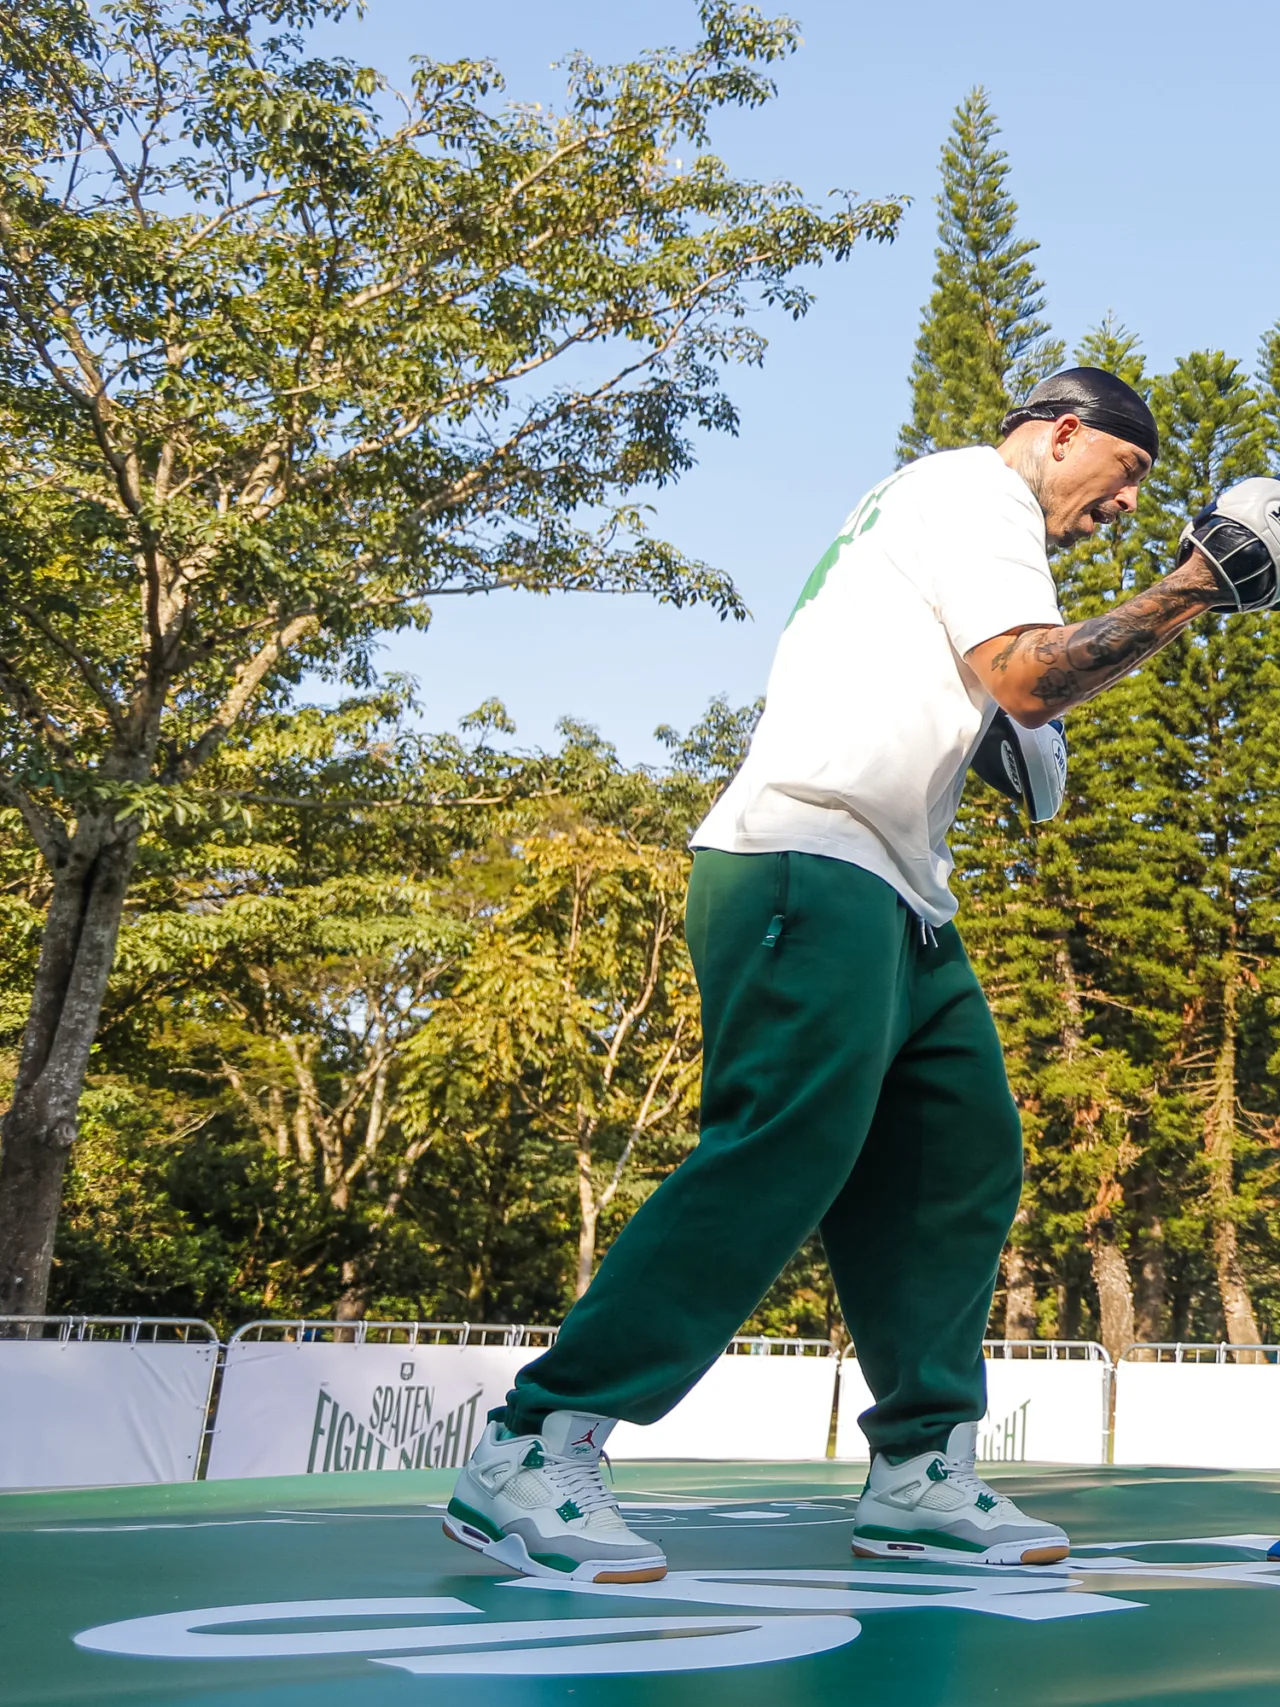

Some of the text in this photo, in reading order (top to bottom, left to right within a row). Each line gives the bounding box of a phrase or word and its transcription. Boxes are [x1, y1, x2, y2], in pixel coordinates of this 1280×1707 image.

[307, 1388, 483, 1473] FIGHT NIGHT
[369, 1385, 435, 1448] SPATEN
[976, 1398, 1031, 1461] IGHT
